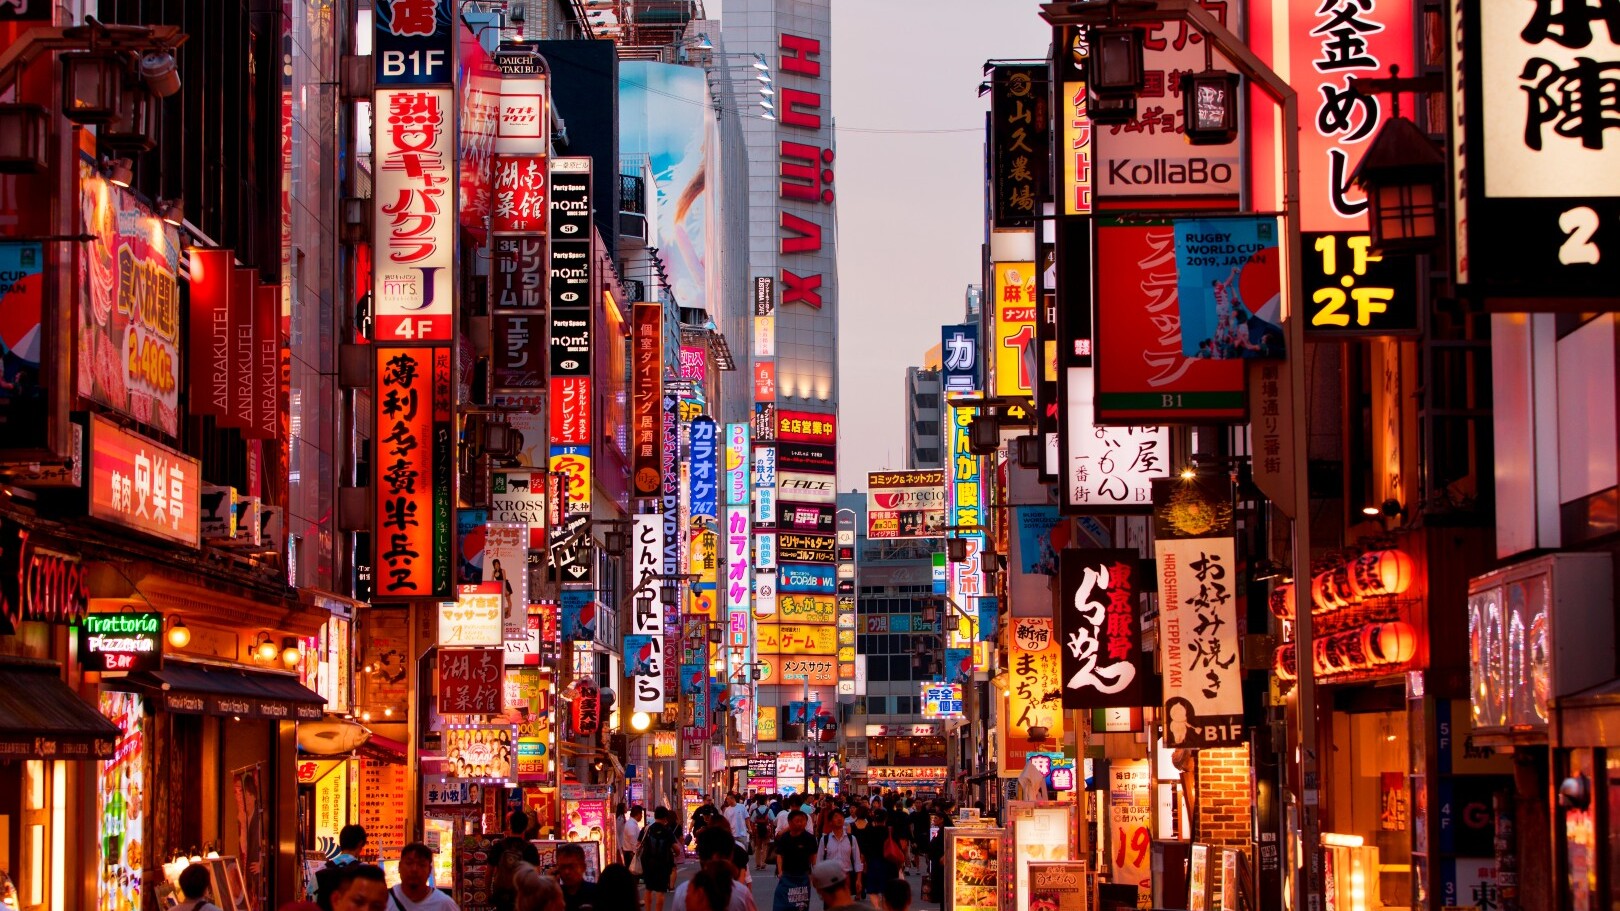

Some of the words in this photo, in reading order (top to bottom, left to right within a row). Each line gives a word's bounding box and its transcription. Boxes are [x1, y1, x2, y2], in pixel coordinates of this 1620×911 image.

[383, 50, 445, 76] B1F
[500, 57, 534, 65] DAIICHI
[1310, 0, 1382, 216] 釜めし
[381, 92, 450, 265] 熟女キャバクラ
[779, 32, 834, 310] HUMAX
[1108, 157, 1232, 185] KollaBo
[510, 220, 528, 230] 4F
[564, 225, 576, 233] 5F
[1557, 205, 1600, 265] 2
[1185, 232, 1232, 243] RUGBY
[1187, 246, 1235, 256] WORLD
[1237, 244, 1265, 254] CUP
[1314, 234, 1383, 276] 1F
[521, 239, 541, 306] レンタル
[1186, 256, 1221, 268] 2019,
[1222, 256, 1267, 267] JAPAN
[564, 292, 576, 300] 4F
[1311, 287, 1395, 328] 2F
[394, 318, 433, 340] 4F
[507, 317, 529, 368] エデン
[213, 307, 227, 409] ANRAKUTEI
[564, 360, 576, 368] 3F
[238, 324, 252, 422] ANRAKUTEI
[262, 339, 275, 434] ANRAKUTEI
[640, 323, 654, 458] 個室ダイニング居酒屋
[562, 379, 575, 443] リフレッシュ
[1161, 393, 1184, 408] B1
[780, 418, 833, 435] 全店営業中
[693, 421, 713, 499] カラオケ
[766, 448, 775, 483] カラオケ
[781, 479, 835, 491] FACE
[1074, 454, 1092, 503] 一番街
[494, 500, 544, 512] XROSS
[692, 501, 714, 514] 747
[760, 489, 771, 520] SEGA
[500, 511, 538, 523] CASA
[485, 538, 520, 546] ッサージ
[702, 531, 715, 569] 麻雀
[760, 535, 771, 567] SEGA
[780, 534, 835, 549] ビリヤード&ダーツ
[729, 511, 747, 604] カラオケ
[463, 584, 479, 593] 2F
[1163, 553, 1179, 612] HIROSHIMA
[86, 614, 158, 633] Trattoria
[731, 613, 747, 632] 24
[1016, 624, 1049, 643] 新宿
[1185, 551, 1236, 700] お好み焼き
[735, 634, 742, 644] H
[782, 634, 815, 649] ゲーム
[1027, 641, 1039, 650] の
[104, 654, 132, 669] Bar
[784, 661, 832, 672] メンズサウナ
[1015, 652, 1041, 729] まっちゃん
[1204, 724, 1243, 741] B1F
[333, 775, 342, 800] Tuna
[333, 802, 342, 845] Restaurant
